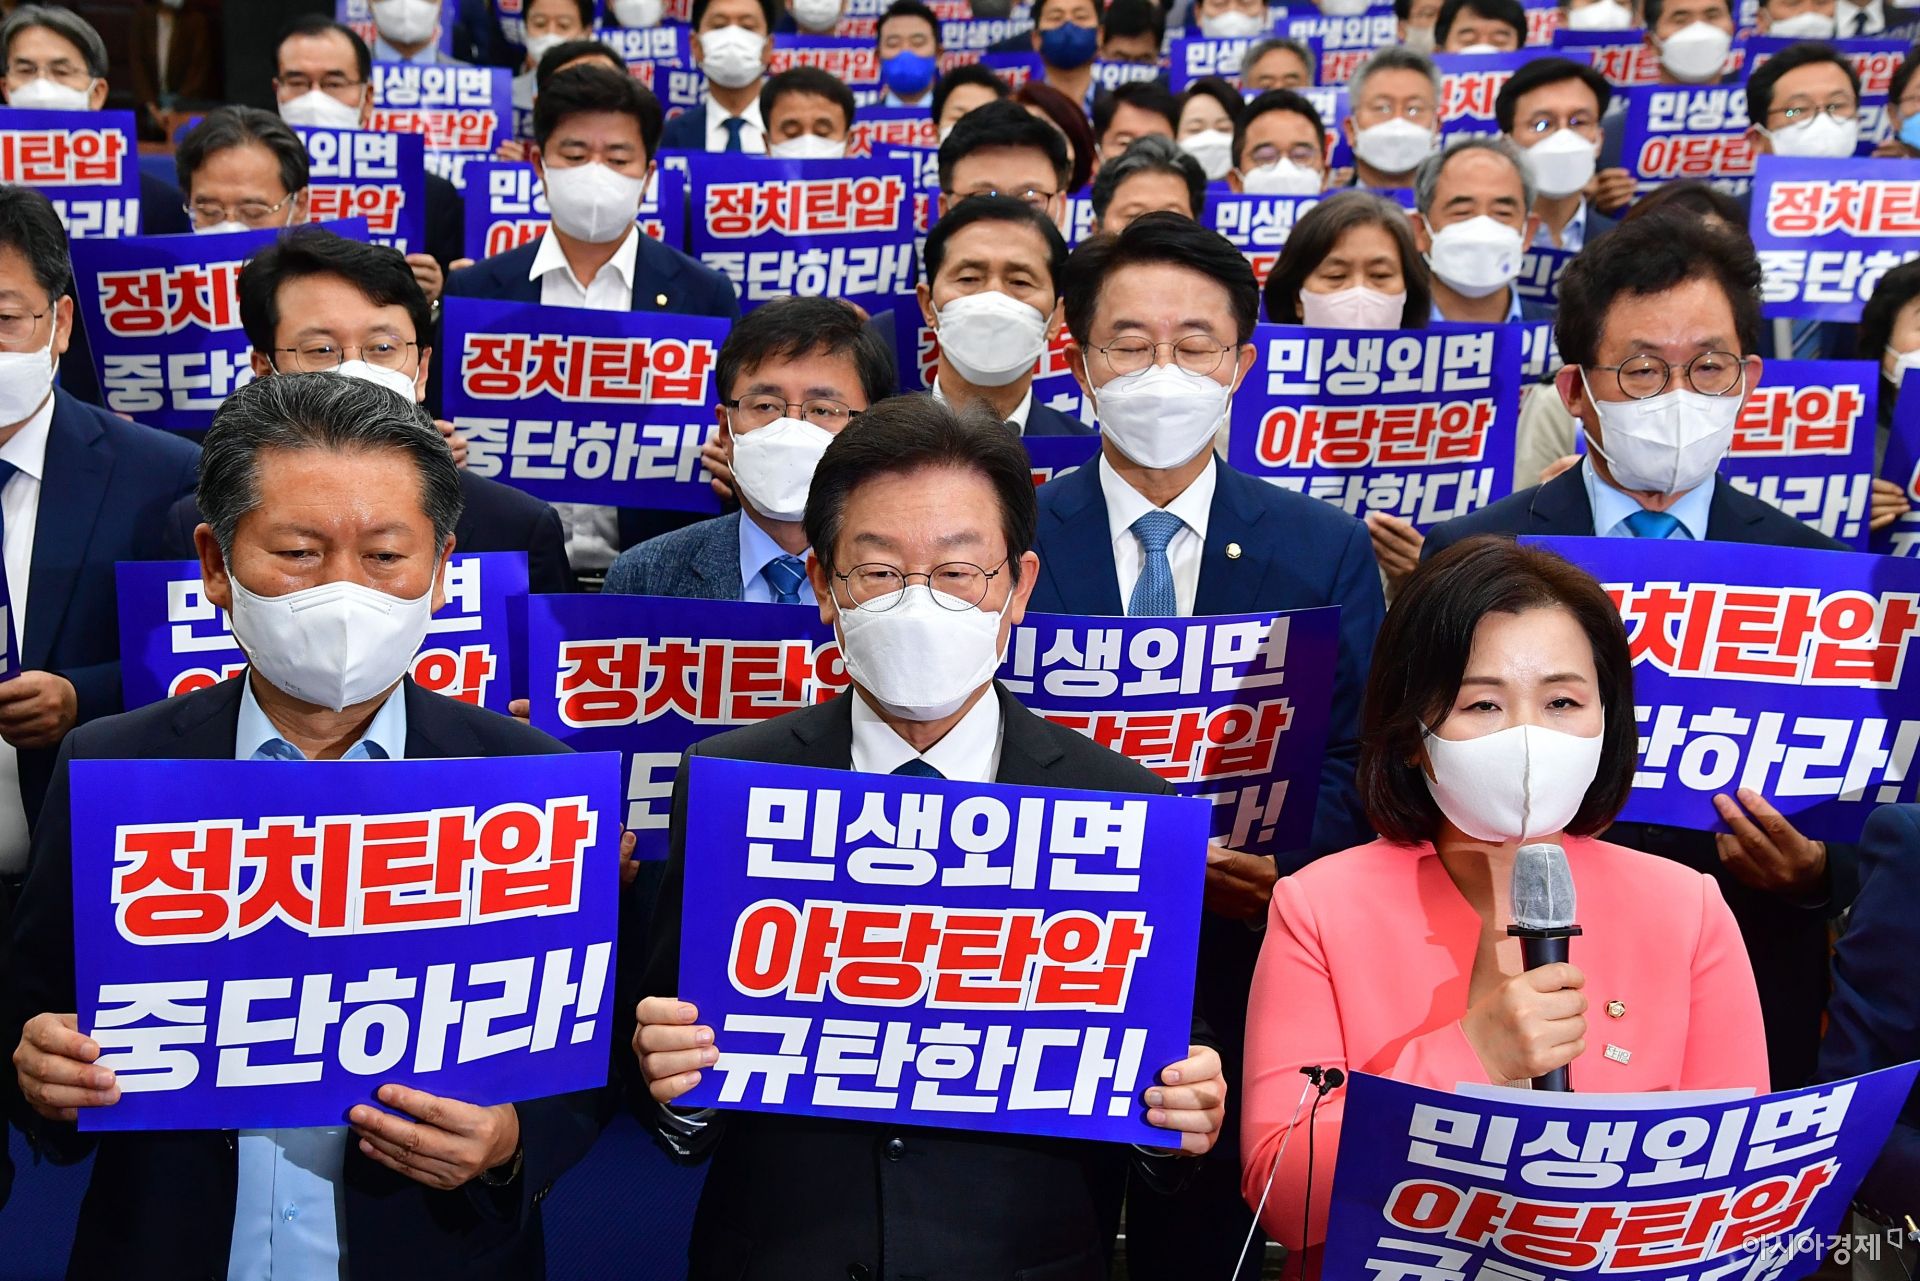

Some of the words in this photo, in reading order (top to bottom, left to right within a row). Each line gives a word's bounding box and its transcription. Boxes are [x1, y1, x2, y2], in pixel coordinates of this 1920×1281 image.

[704, 175, 906, 239] 정치탄압
[1216, 199, 1319, 246] 민생
[97, 259, 254, 338] 정치
[700, 244, 914, 301] 중단하라!
[461, 333, 718, 406] 정치탄압
[1267, 331, 1495, 396] 민생외면
[1255, 397, 1497, 469] 야당탄압
[1258, 467, 1496, 529] 탄한다!
[1599, 581, 1920, 690] 치탄압
[111, 796, 598, 946] 정치탄압
[746, 787, 1148, 893] 민생외면
[727, 898, 1153, 1014] 야당탄압
[90, 942, 612, 1093] 중단하라!
[714, 1014, 1148, 1117] 규탄한다!
[1407, 1082, 1858, 1189] 민생외면
[1382, 1157, 1841, 1272] 야당탄압
